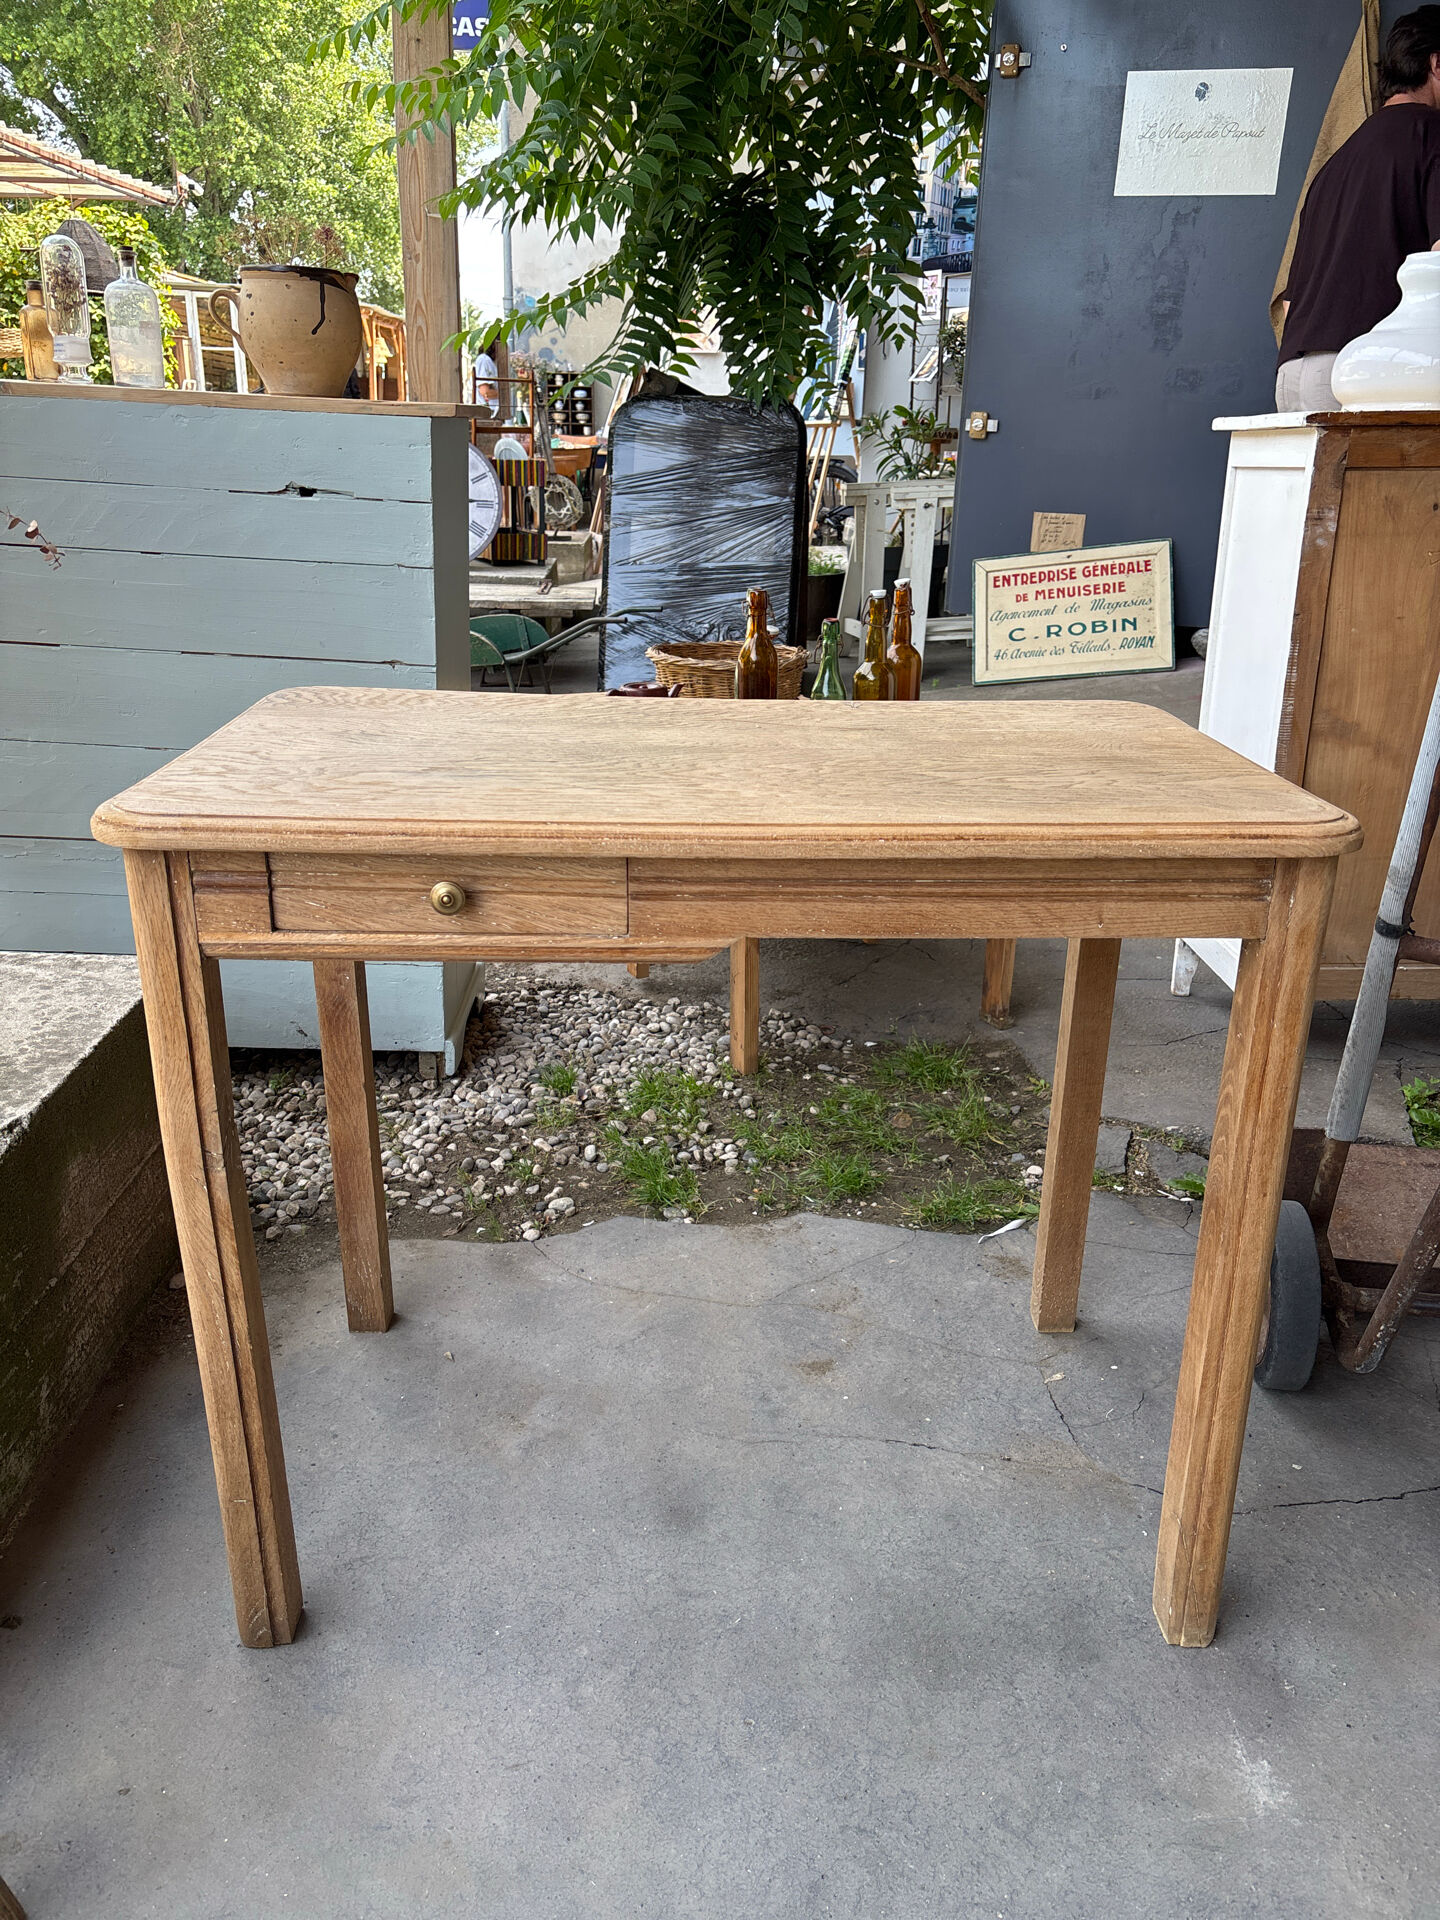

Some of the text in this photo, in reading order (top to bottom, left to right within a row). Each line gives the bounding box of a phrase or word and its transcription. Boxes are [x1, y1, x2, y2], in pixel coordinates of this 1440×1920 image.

[1138, 122, 1157, 139] Le
[1203, 125, 1220, 139] de
[992, 559, 1153, 589] ENTREPRISE GÉNÉRALE
[1015, 581, 1127, 603] DE MENUISERIE
[989, 597, 1153, 625] Agencement de Magasins
[1046, 617, 1138, 639] ROBIN
[1010, 647, 1048, 660] Avenue
[1049, 645, 1065, 656] des
[1119, 635, 1156, 650] ROYAN
